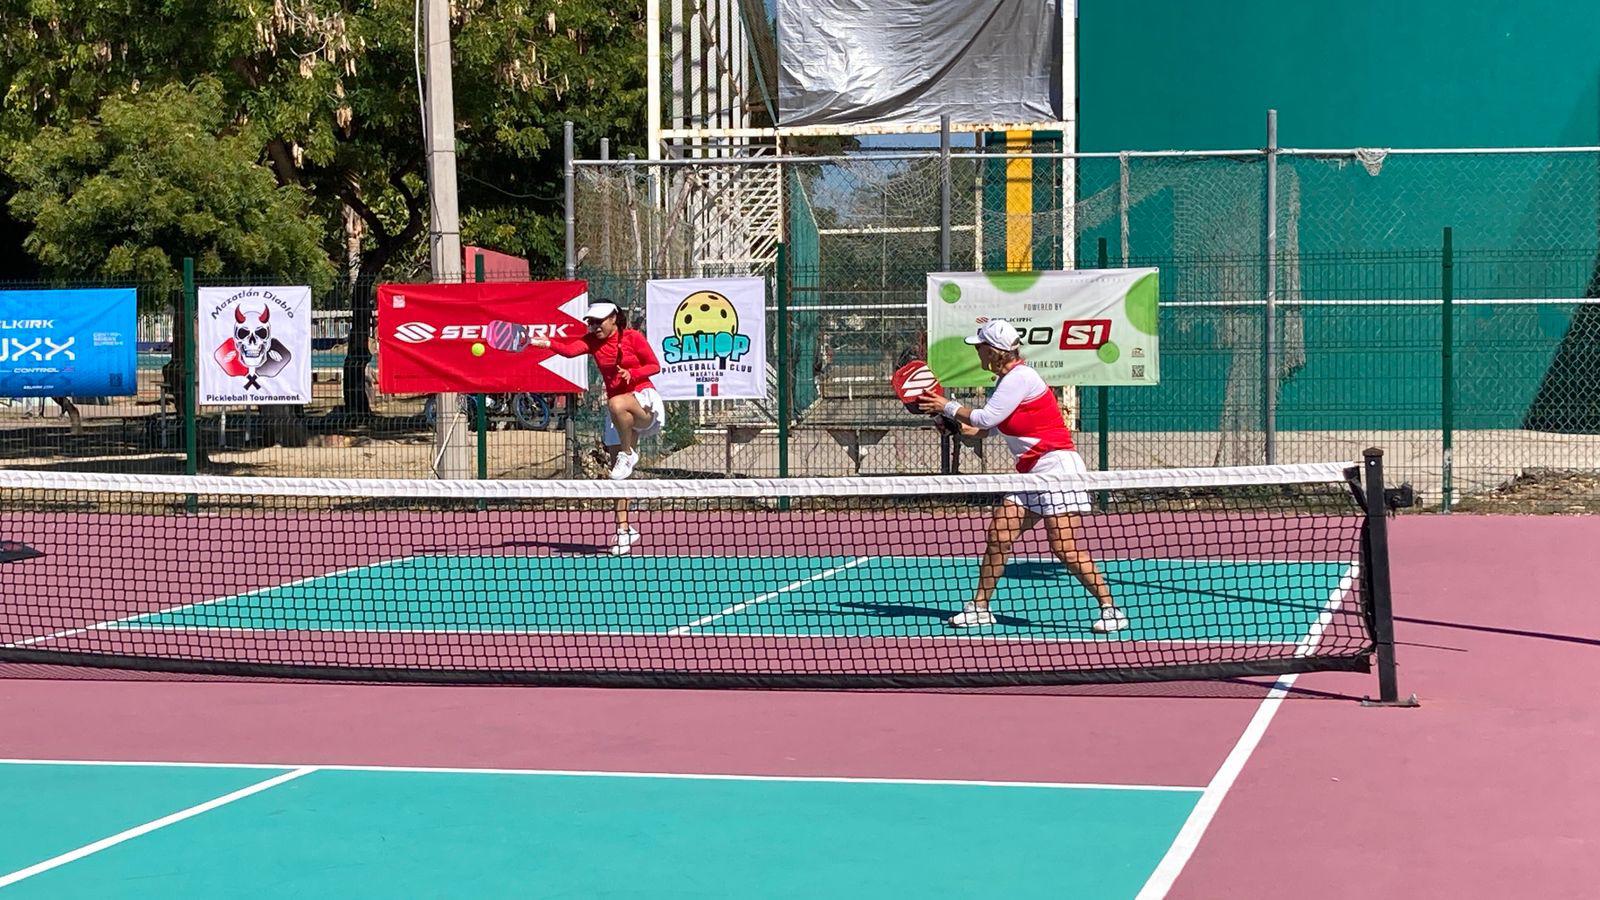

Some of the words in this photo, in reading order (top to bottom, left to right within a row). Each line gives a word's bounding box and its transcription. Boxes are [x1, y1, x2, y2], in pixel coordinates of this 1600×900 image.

[263, 290, 295, 319] Diablo
[1054, 302, 1063, 311] BY
[0, 319, 54, 329] LKIRK
[439, 323, 570, 340] SELRK
[1066, 324, 1104, 346] S1
[662, 331, 751, 364] SAHOP
[662, 363, 716, 375] PICKLEBALL
[729, 363, 753, 373] CLUB
[206, 394, 248, 402] Pickleball
[249, 393, 300, 401] Tournament
